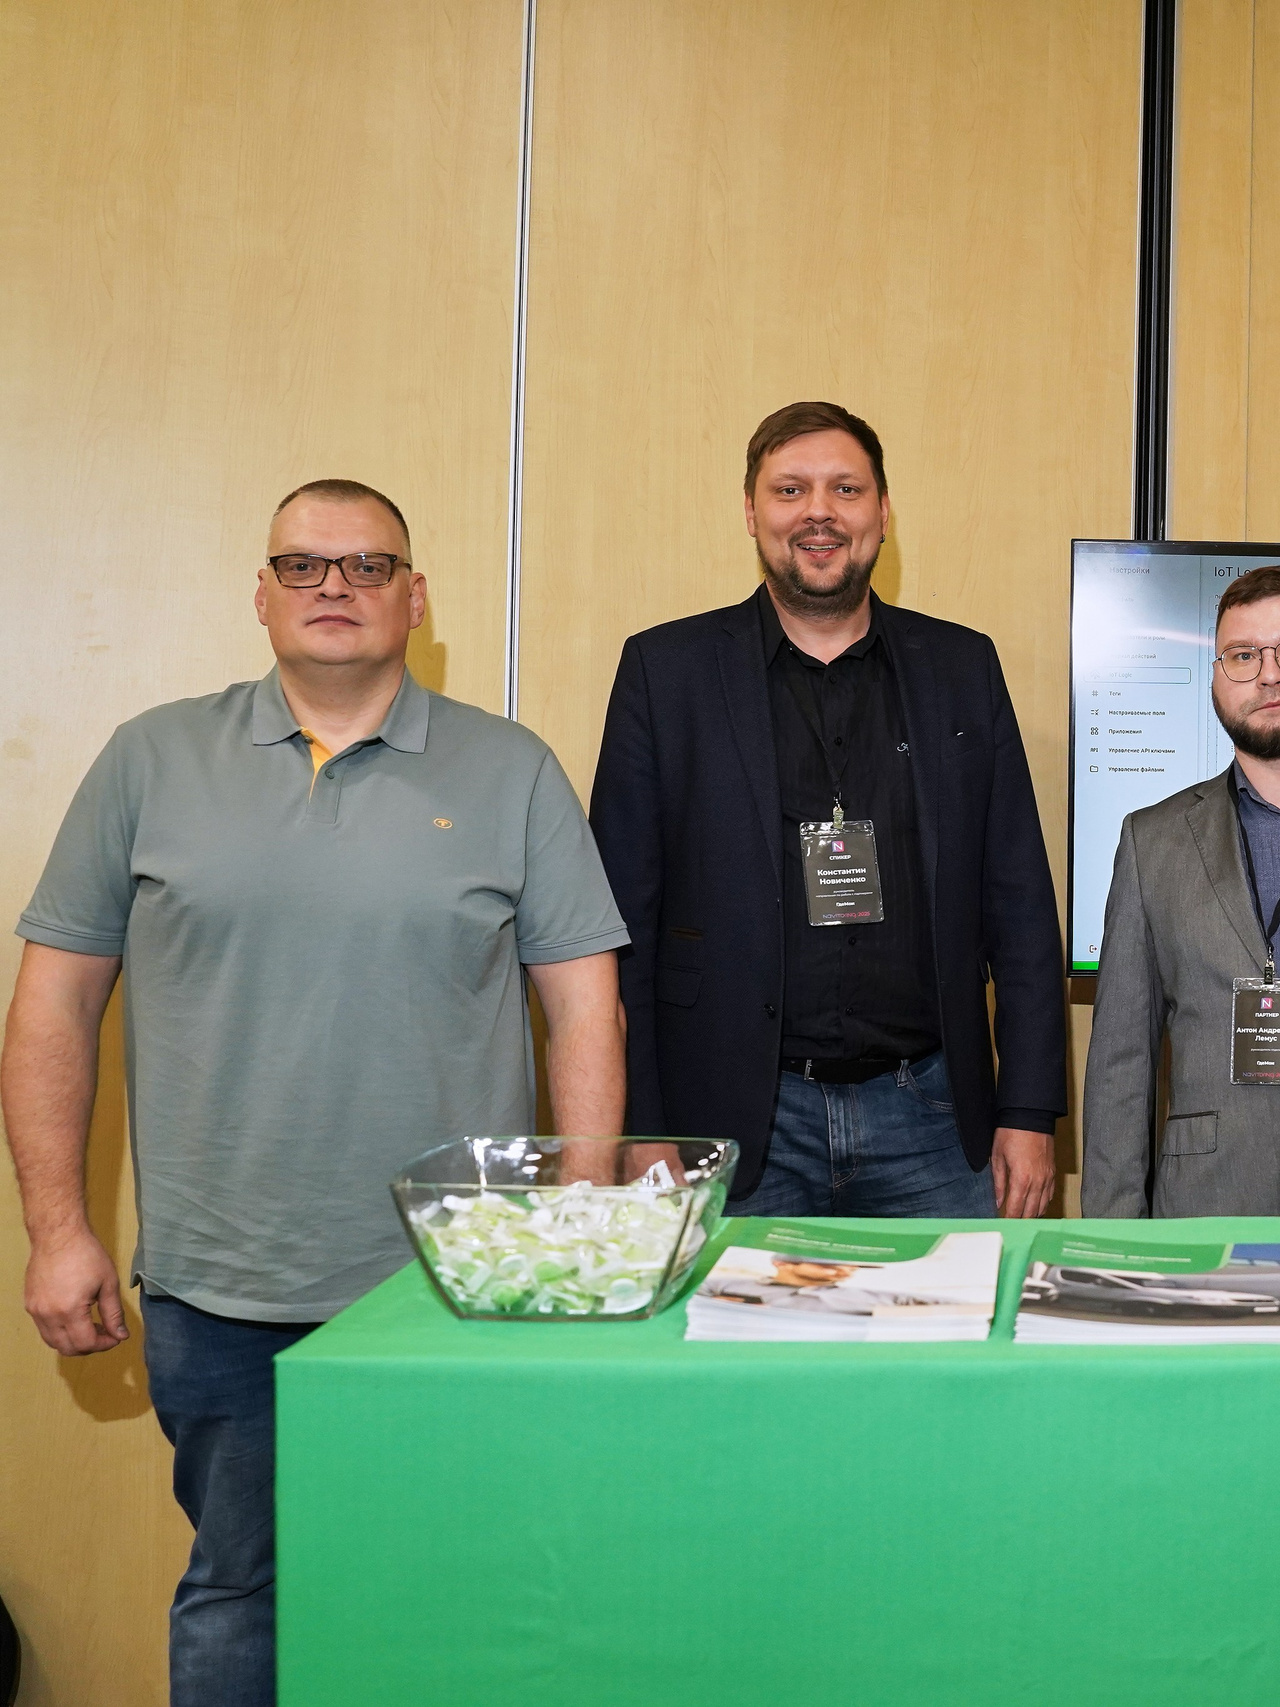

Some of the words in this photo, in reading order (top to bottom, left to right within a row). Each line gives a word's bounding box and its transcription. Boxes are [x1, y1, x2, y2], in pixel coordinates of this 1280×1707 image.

[1109, 567, 1150, 575] Настройки
[1214, 567, 1233, 577] IoT
[817, 868, 866, 876] Константин
[819, 877, 866, 885] Новиченко
